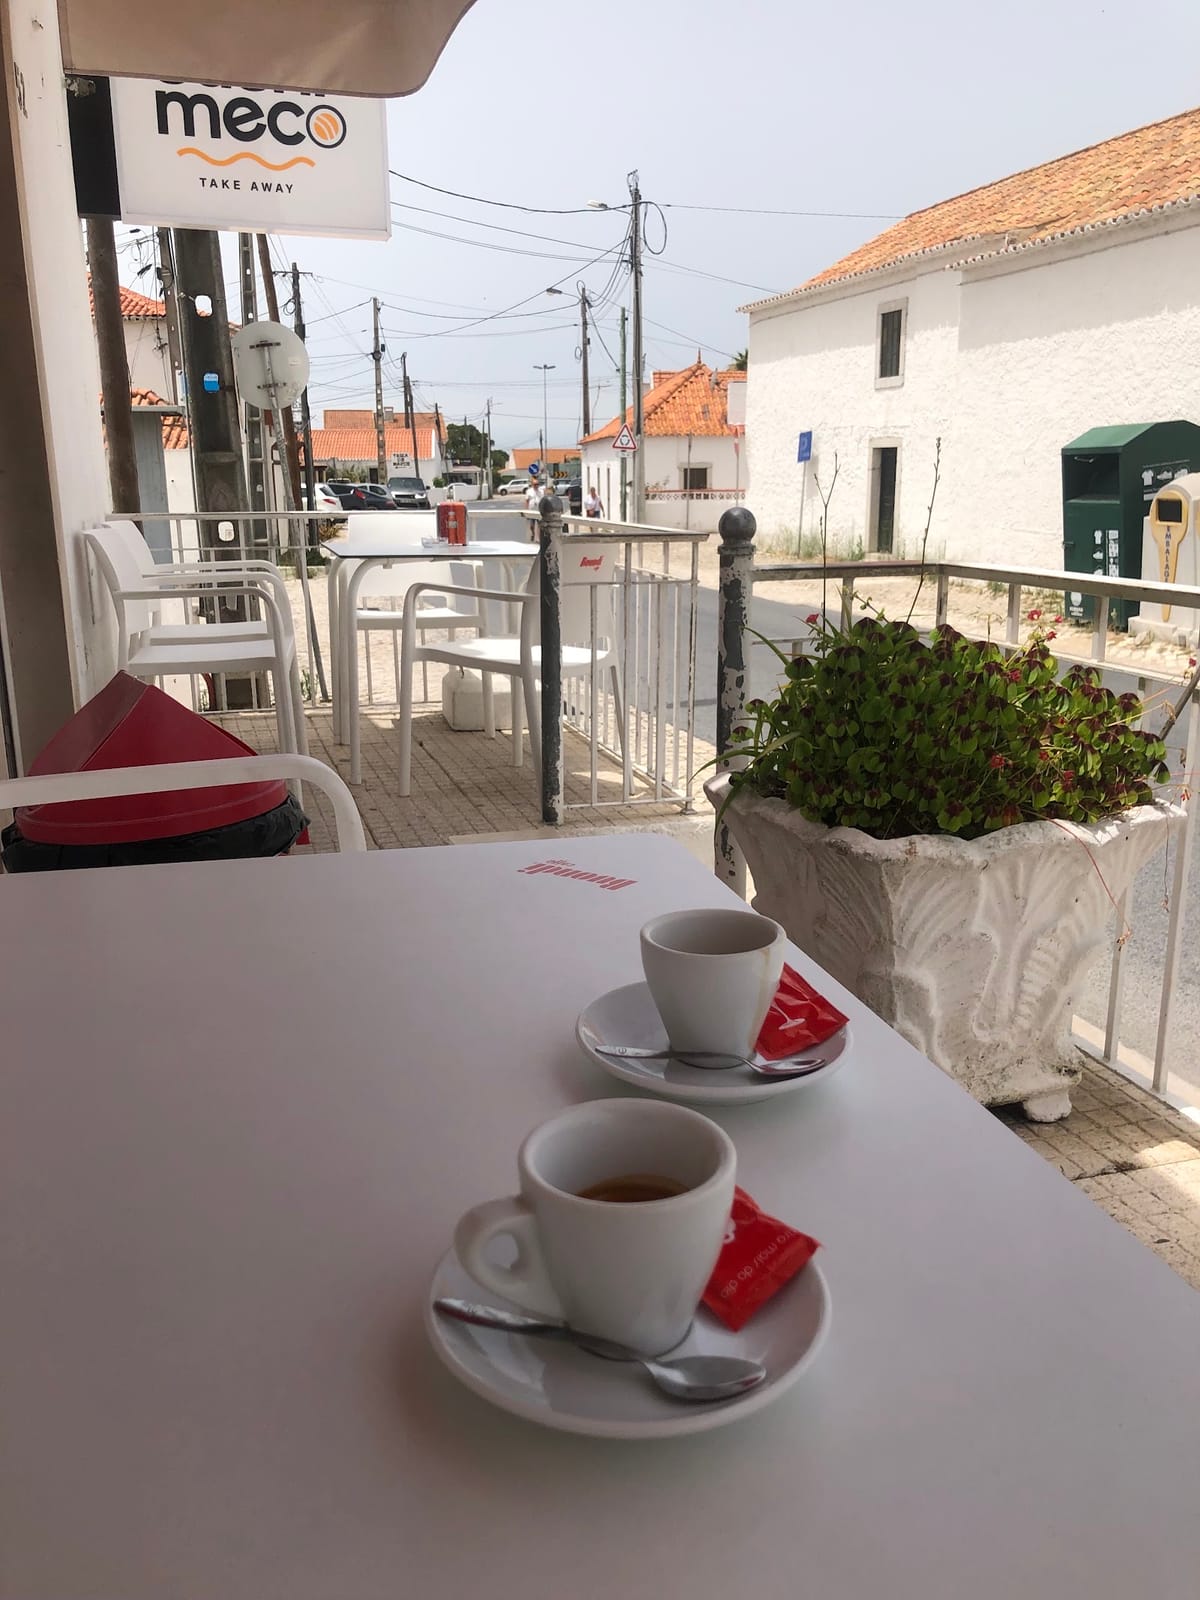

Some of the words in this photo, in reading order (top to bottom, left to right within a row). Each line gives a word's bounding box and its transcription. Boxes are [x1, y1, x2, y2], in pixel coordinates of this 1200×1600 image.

[155, 90, 346, 149] meco
[199, 177, 241, 190] TAKE
[250, 181, 293, 194] AWAY
[737, 1265, 753, 1281] do
